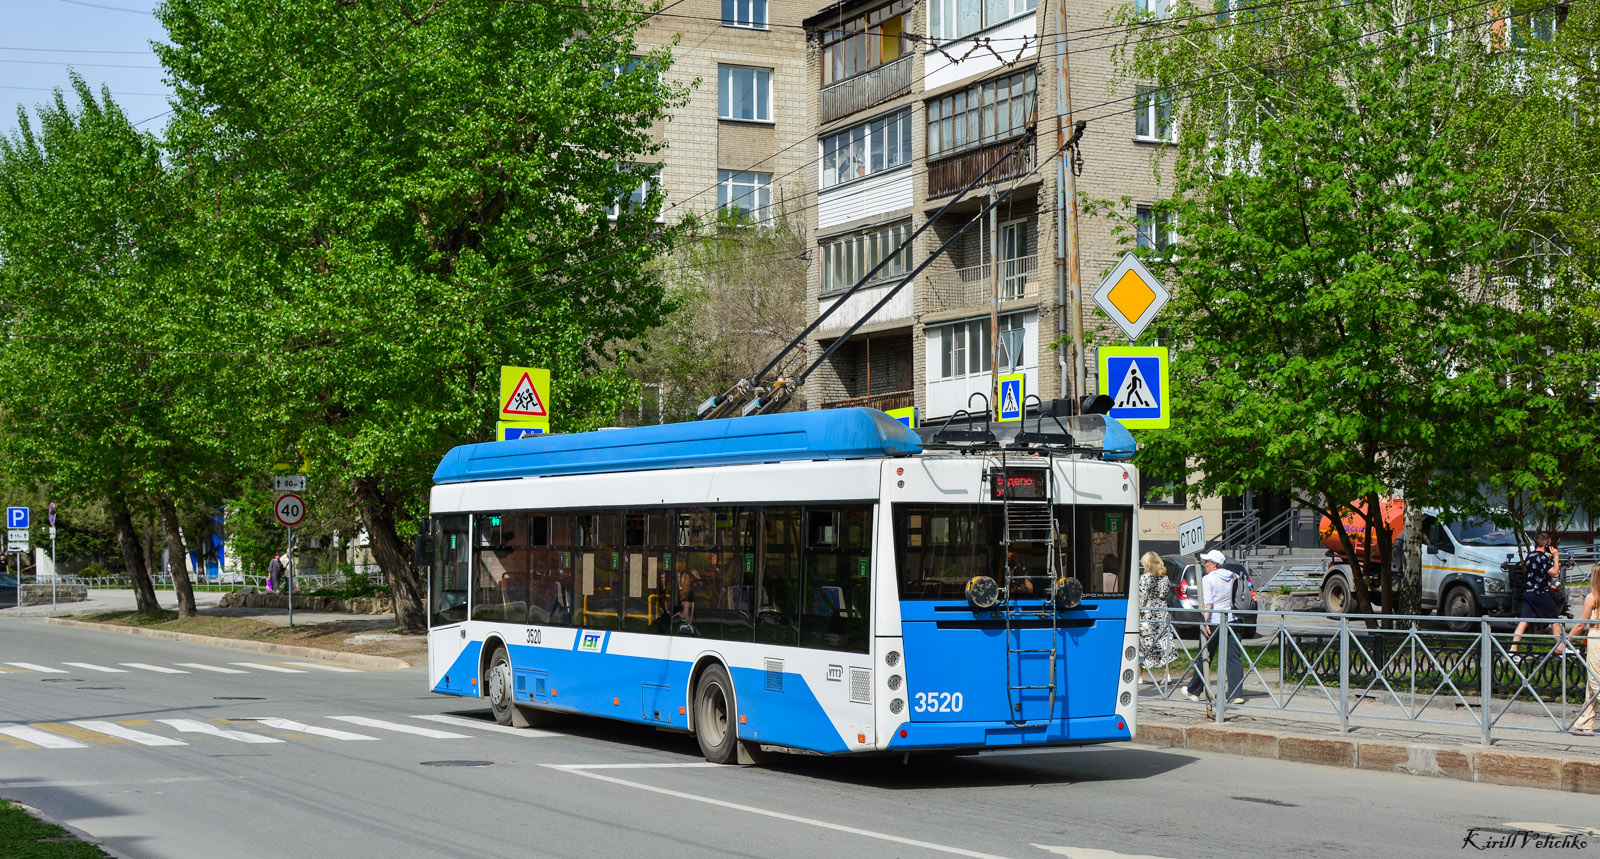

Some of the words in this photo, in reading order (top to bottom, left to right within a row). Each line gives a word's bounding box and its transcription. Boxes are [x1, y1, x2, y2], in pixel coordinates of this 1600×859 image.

[1007, 477, 1033, 487] депо
[281, 504, 300, 517] 40
[1180, 526, 1203, 549] СТОП
[526, 628, 542, 644] 3520
[914, 691, 964, 713] 3520
